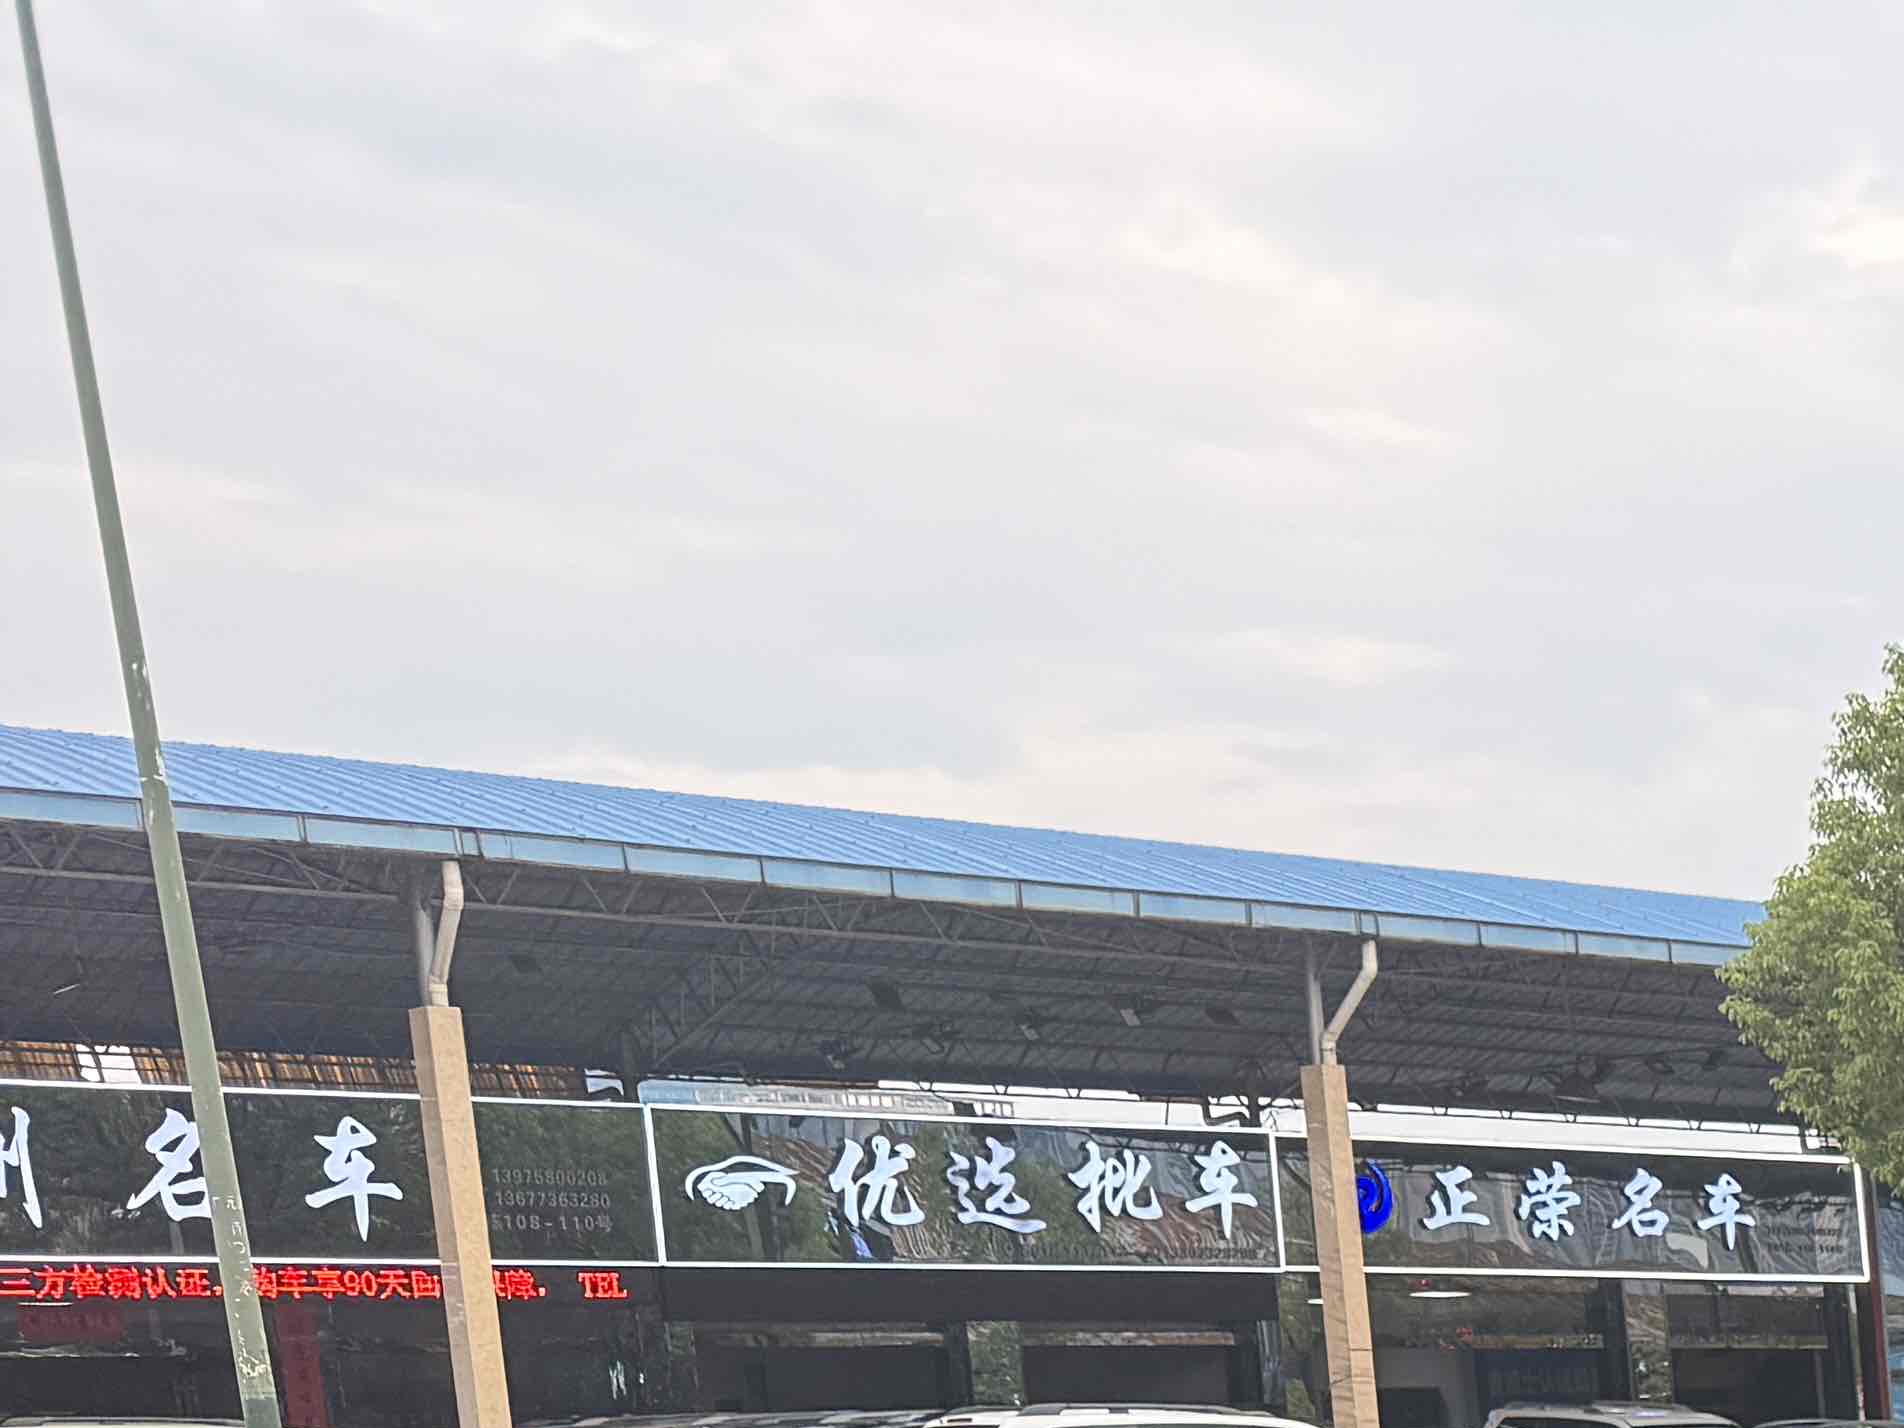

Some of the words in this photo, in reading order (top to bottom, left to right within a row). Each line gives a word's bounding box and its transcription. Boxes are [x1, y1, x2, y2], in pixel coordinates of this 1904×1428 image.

[828, 1134, 1258, 1240] 优选批车
[1422, 1159, 1757, 1251] 正荣名车
[577, 1272, 628, 1300] TEL
